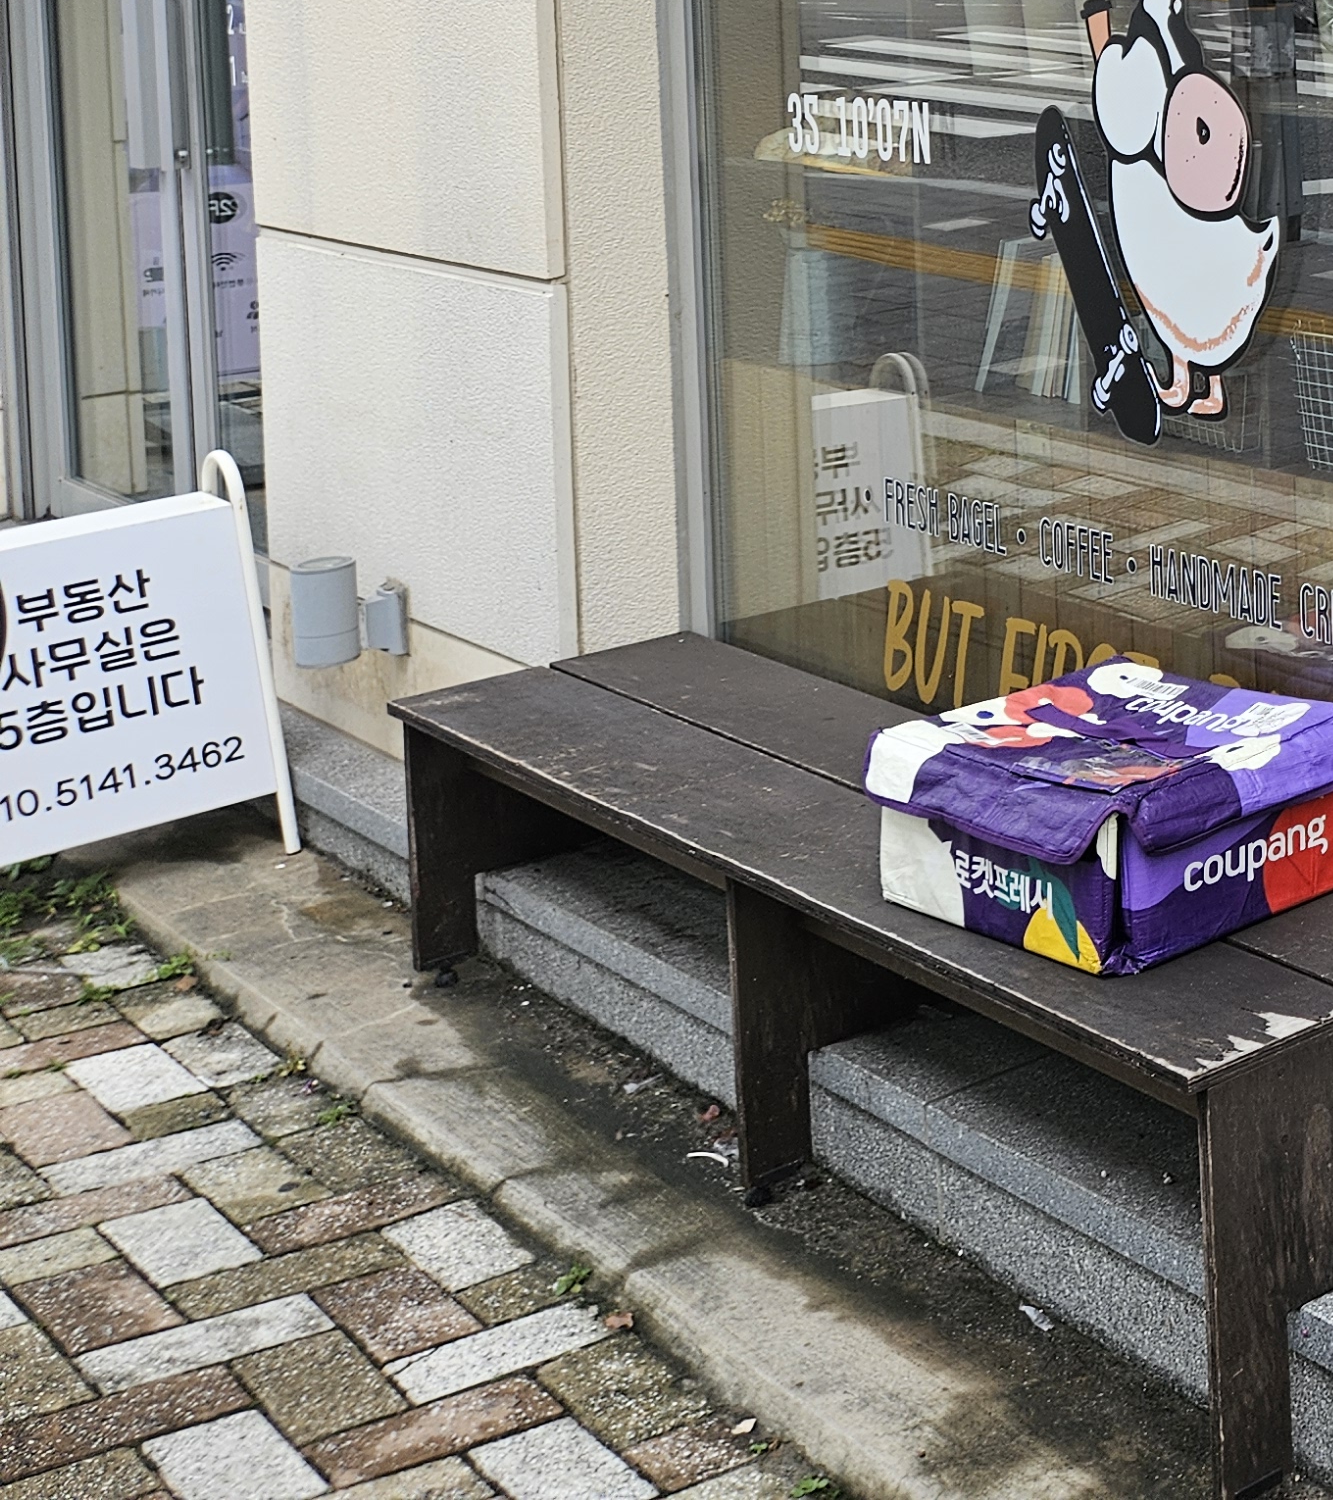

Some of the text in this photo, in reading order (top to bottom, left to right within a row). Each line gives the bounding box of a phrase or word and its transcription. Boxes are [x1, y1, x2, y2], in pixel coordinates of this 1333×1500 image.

[788, 92, 819, 155] 35
[883, 476, 940, 537] FRESH
[947, 492, 1007, 557] BAGEL
[1039, 516, 1115, 584] COFFEE
[1149, 543, 1283, 631] HANDMADE
[16, 568, 151, 633] 부동산
[2, 617, 181, 693] 사무실은
[883, 579, 985, 708] BUT
[0, 666, 205, 751] 5층입니다
[954, 850, 1054, 920] 로켓프레시
[1183, 814, 1329, 893] coupang
